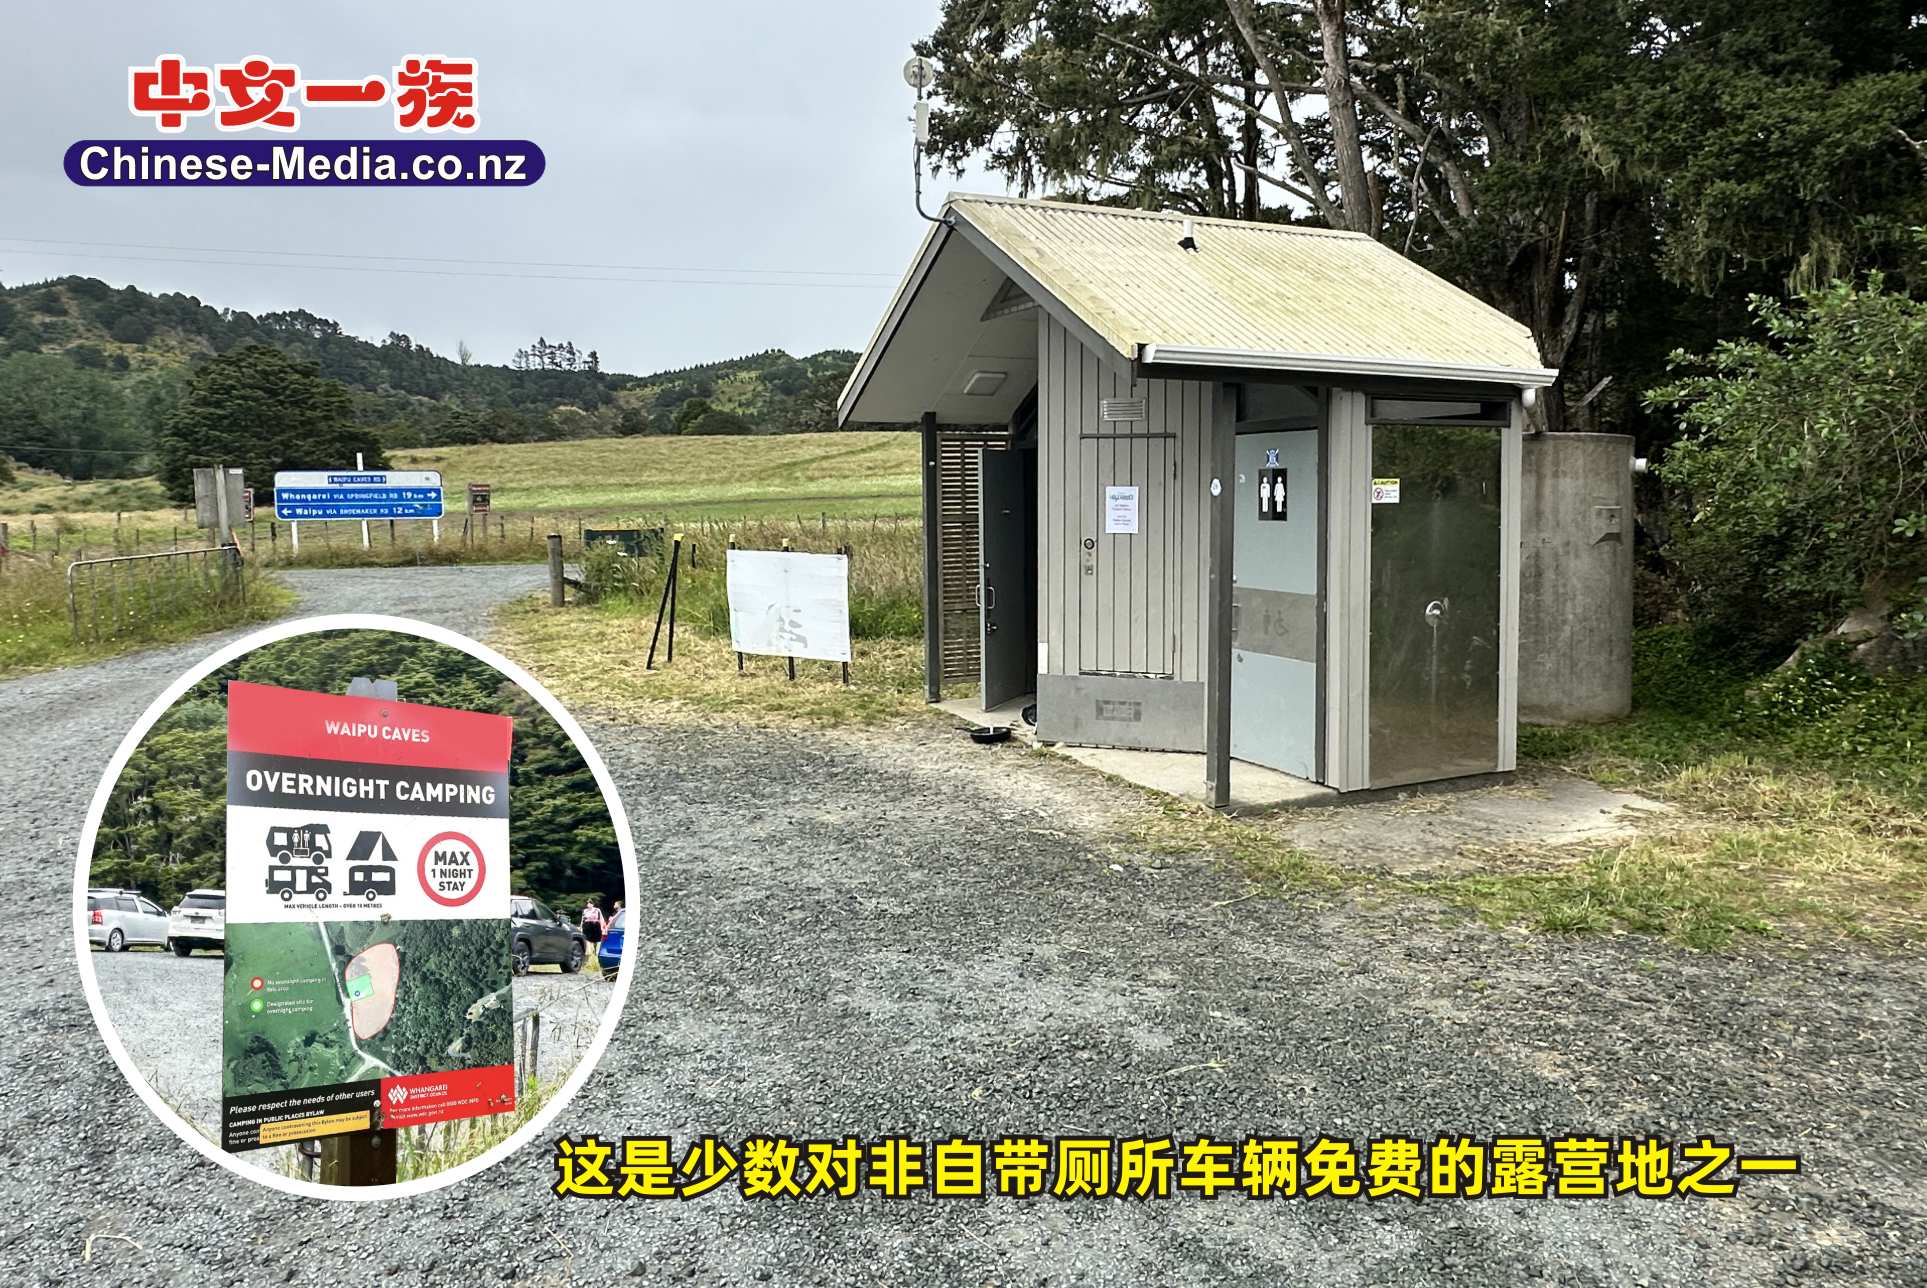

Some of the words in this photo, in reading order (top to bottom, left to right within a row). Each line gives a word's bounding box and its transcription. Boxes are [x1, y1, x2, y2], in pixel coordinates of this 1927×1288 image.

[281, 492, 331, 502] Whangarei
[295, 508, 323, 516] Waipu
[325, 720, 378, 738] WAIPU
[382, 727, 431, 743] CAVES
[246, 769, 389, 800] OVERNIGHT
[395, 780, 496, 805] CAMPING
[434, 850, 470, 866] MAX
[431, 869, 436, 879] 1
[440, 868, 474, 879] NIGHT
[438, 881, 466, 892] STAY
[409, 1084, 448, 1094] WHANGAREI
[229, 1104, 257, 1114] Please
[258, 1101, 288, 1111] respect
[289, 1097, 301, 1107] the
[302, 1095, 325, 1105] needs
[326, 1093, 334, 1102] of
[335, 1091, 354, 1101] other
[355, 1089, 375, 1098] users
[229, 1119, 256, 1128] CAMPING
[263, 1115, 284, 1123] PUBLIC
[284, 1111, 305, 1120] PLACES
[305, 1109, 325, 1117] BYLAW
[229, 1130, 249, 1138] Anyone
